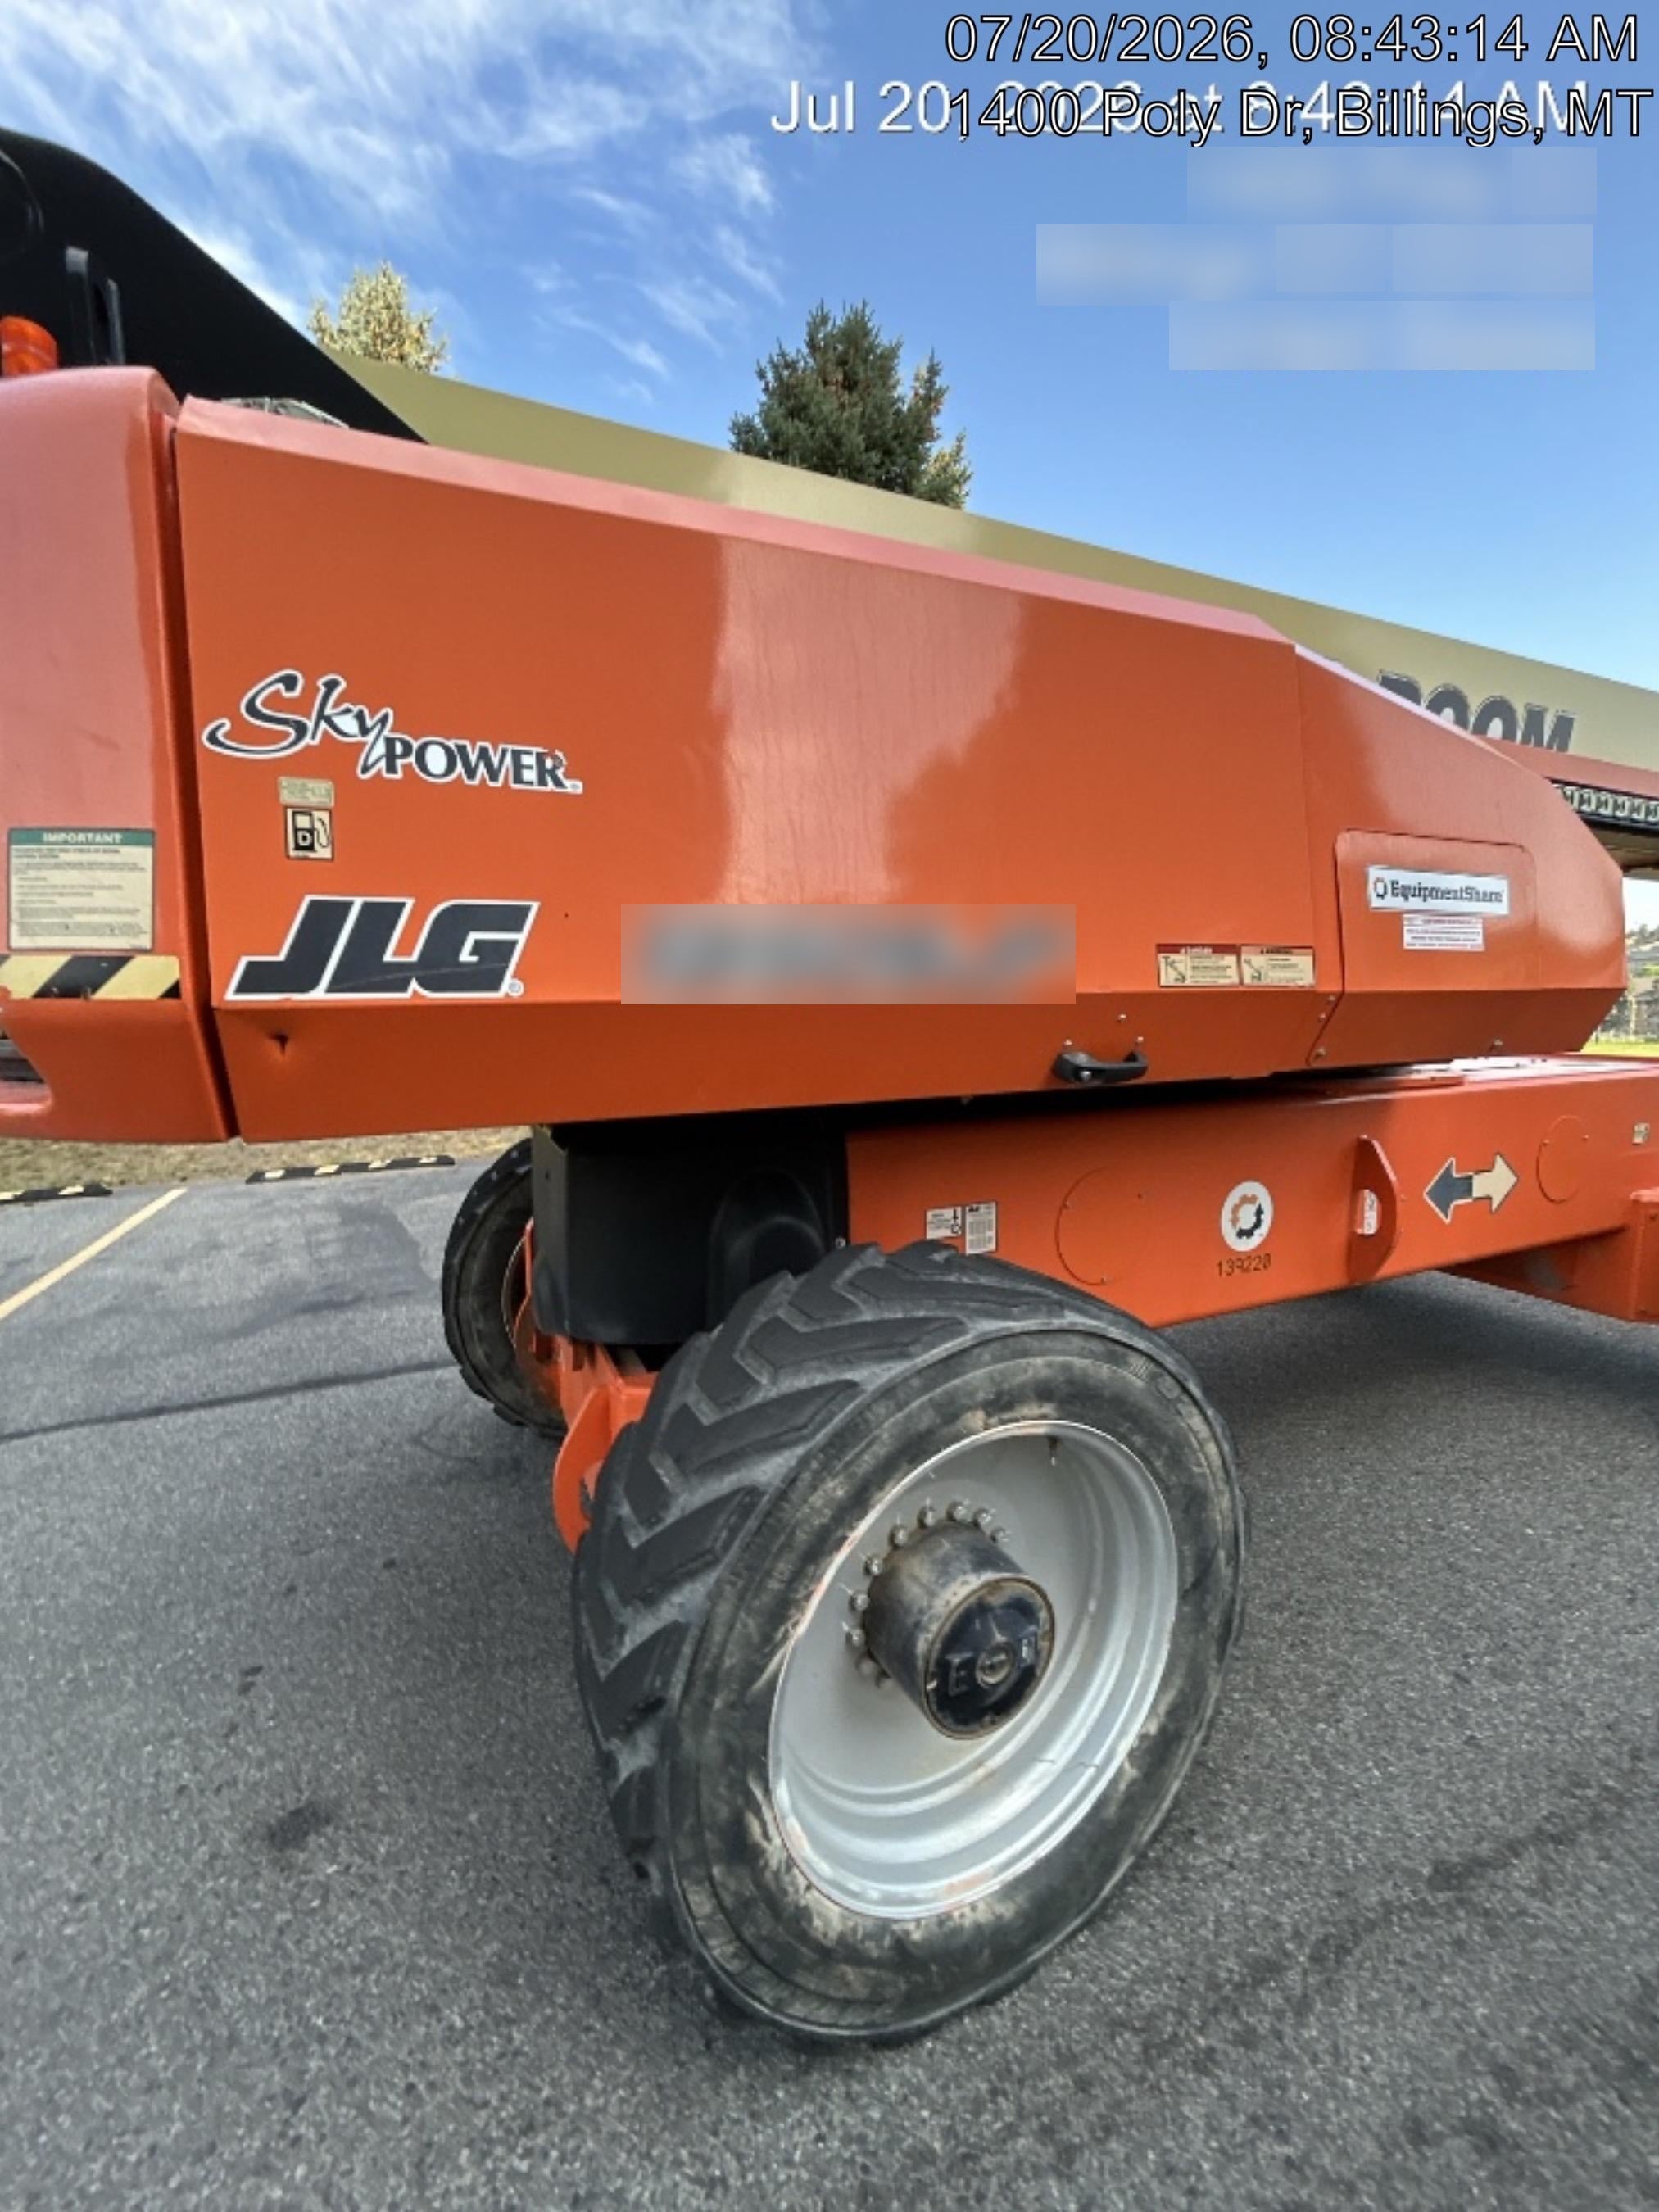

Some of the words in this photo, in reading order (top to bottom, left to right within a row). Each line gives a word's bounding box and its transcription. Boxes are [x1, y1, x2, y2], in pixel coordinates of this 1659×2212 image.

[202, 669, 393, 779] Sky
[382, 735, 570, 791] POWER
[43, 831, 123, 844] IMPORTANT
[1390, 879, 1503, 904] EquipmentShare
[225, 894, 541, 1001] JLG
